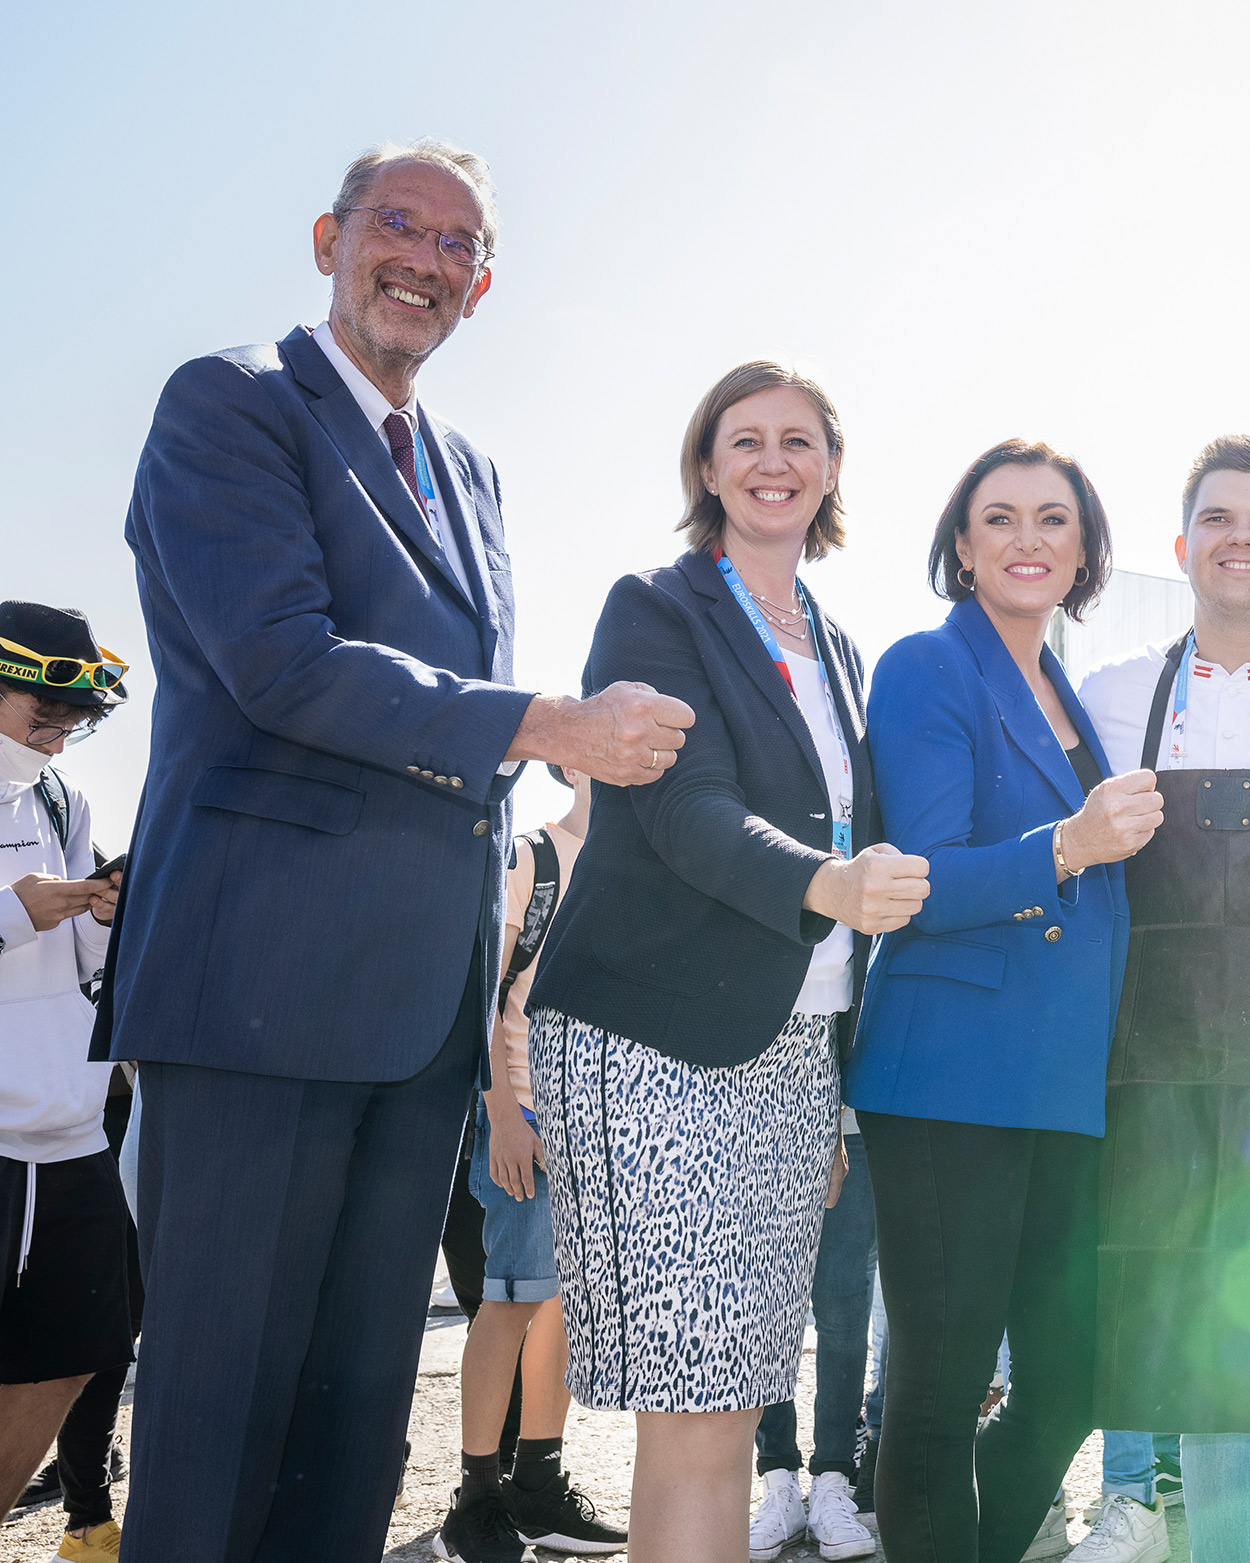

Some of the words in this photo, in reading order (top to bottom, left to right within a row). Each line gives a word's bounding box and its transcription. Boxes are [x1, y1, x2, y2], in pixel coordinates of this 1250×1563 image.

[731, 583, 761, 625] EUROSKILLS
[756, 625, 771, 644] 2021
[0, 662, 37, 679] REXIN
